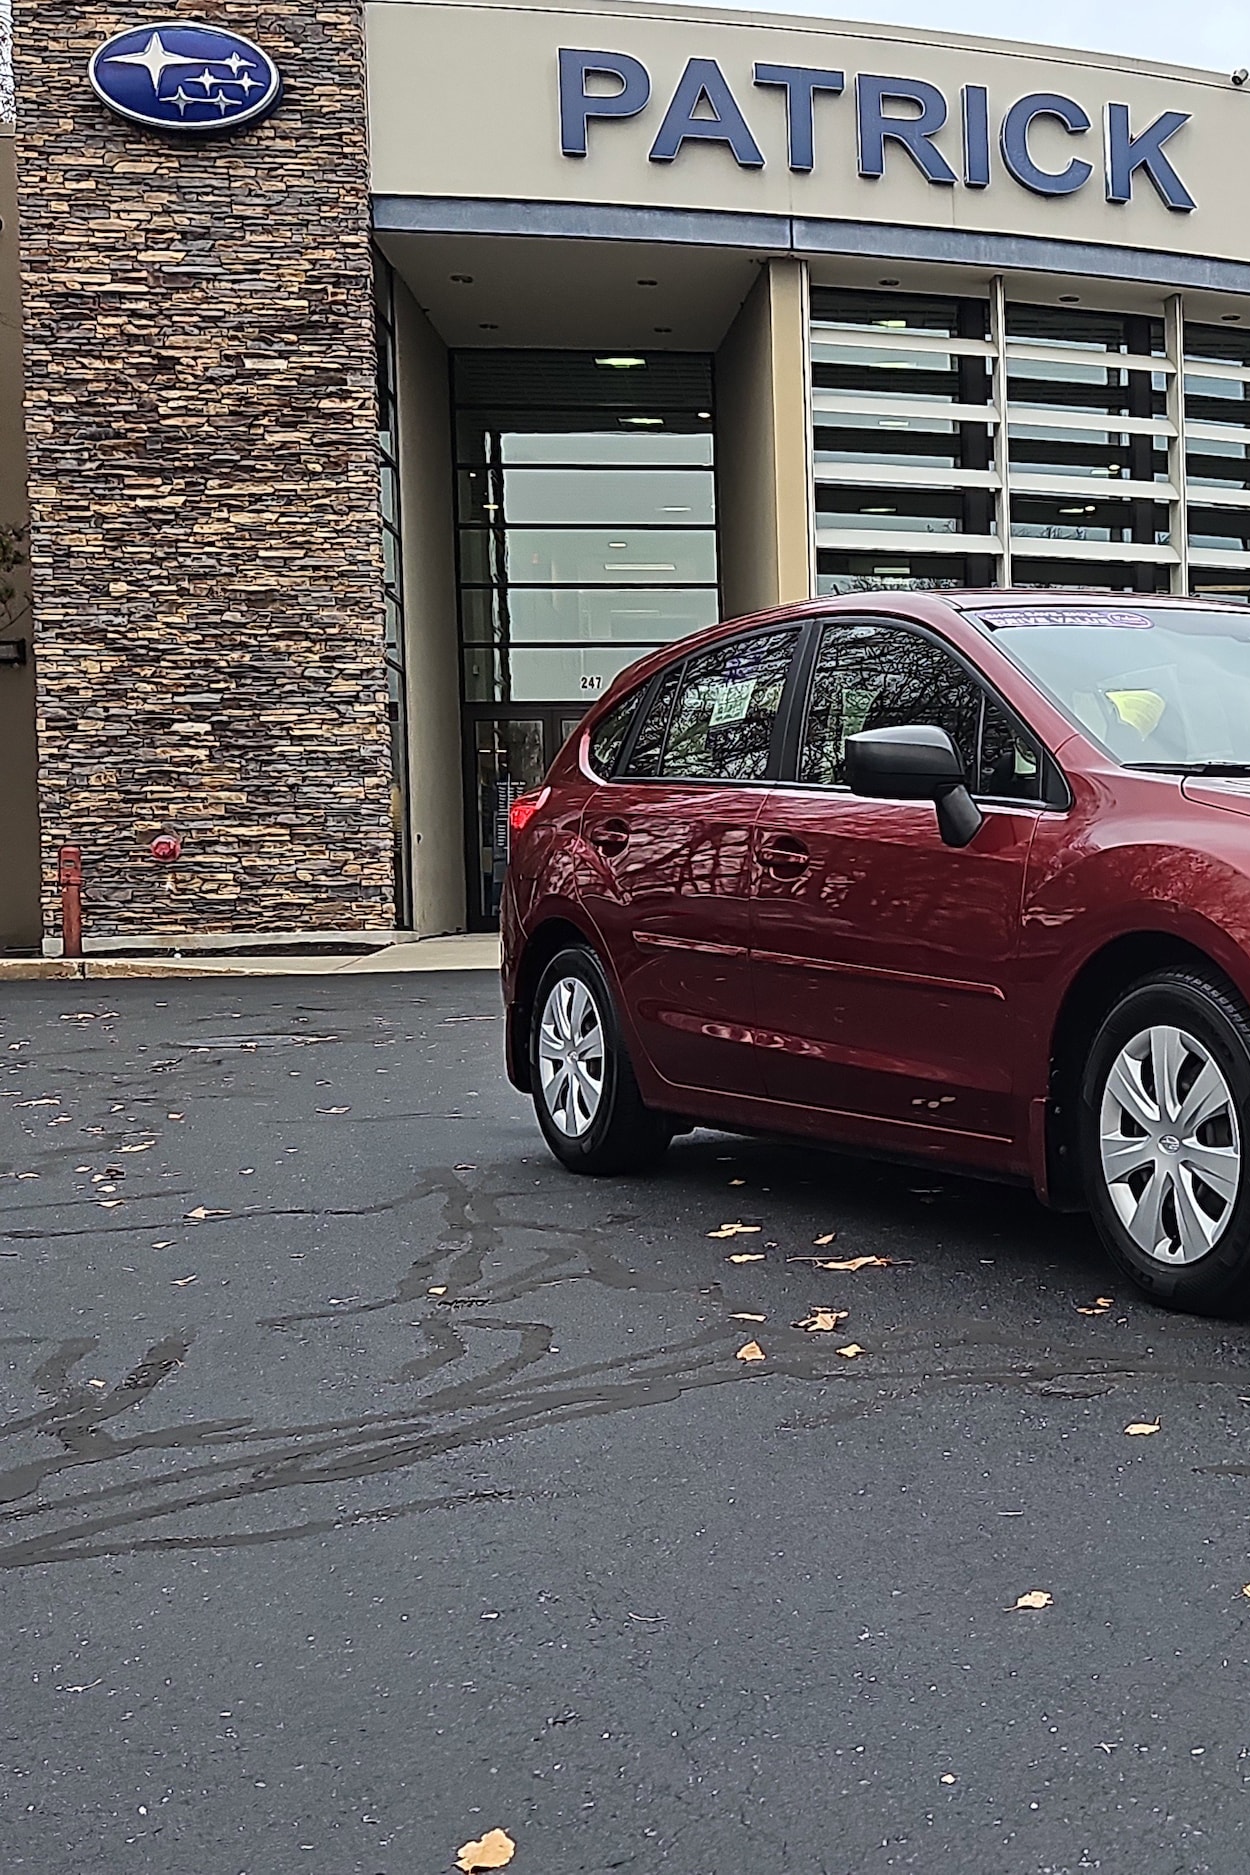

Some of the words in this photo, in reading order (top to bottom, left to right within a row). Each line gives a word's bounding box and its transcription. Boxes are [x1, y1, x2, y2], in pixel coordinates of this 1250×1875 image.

[557, 47, 1198, 213] PATRICK
[1049, 616, 1110, 625] VALUE
[581, 676, 602, 689] 247
